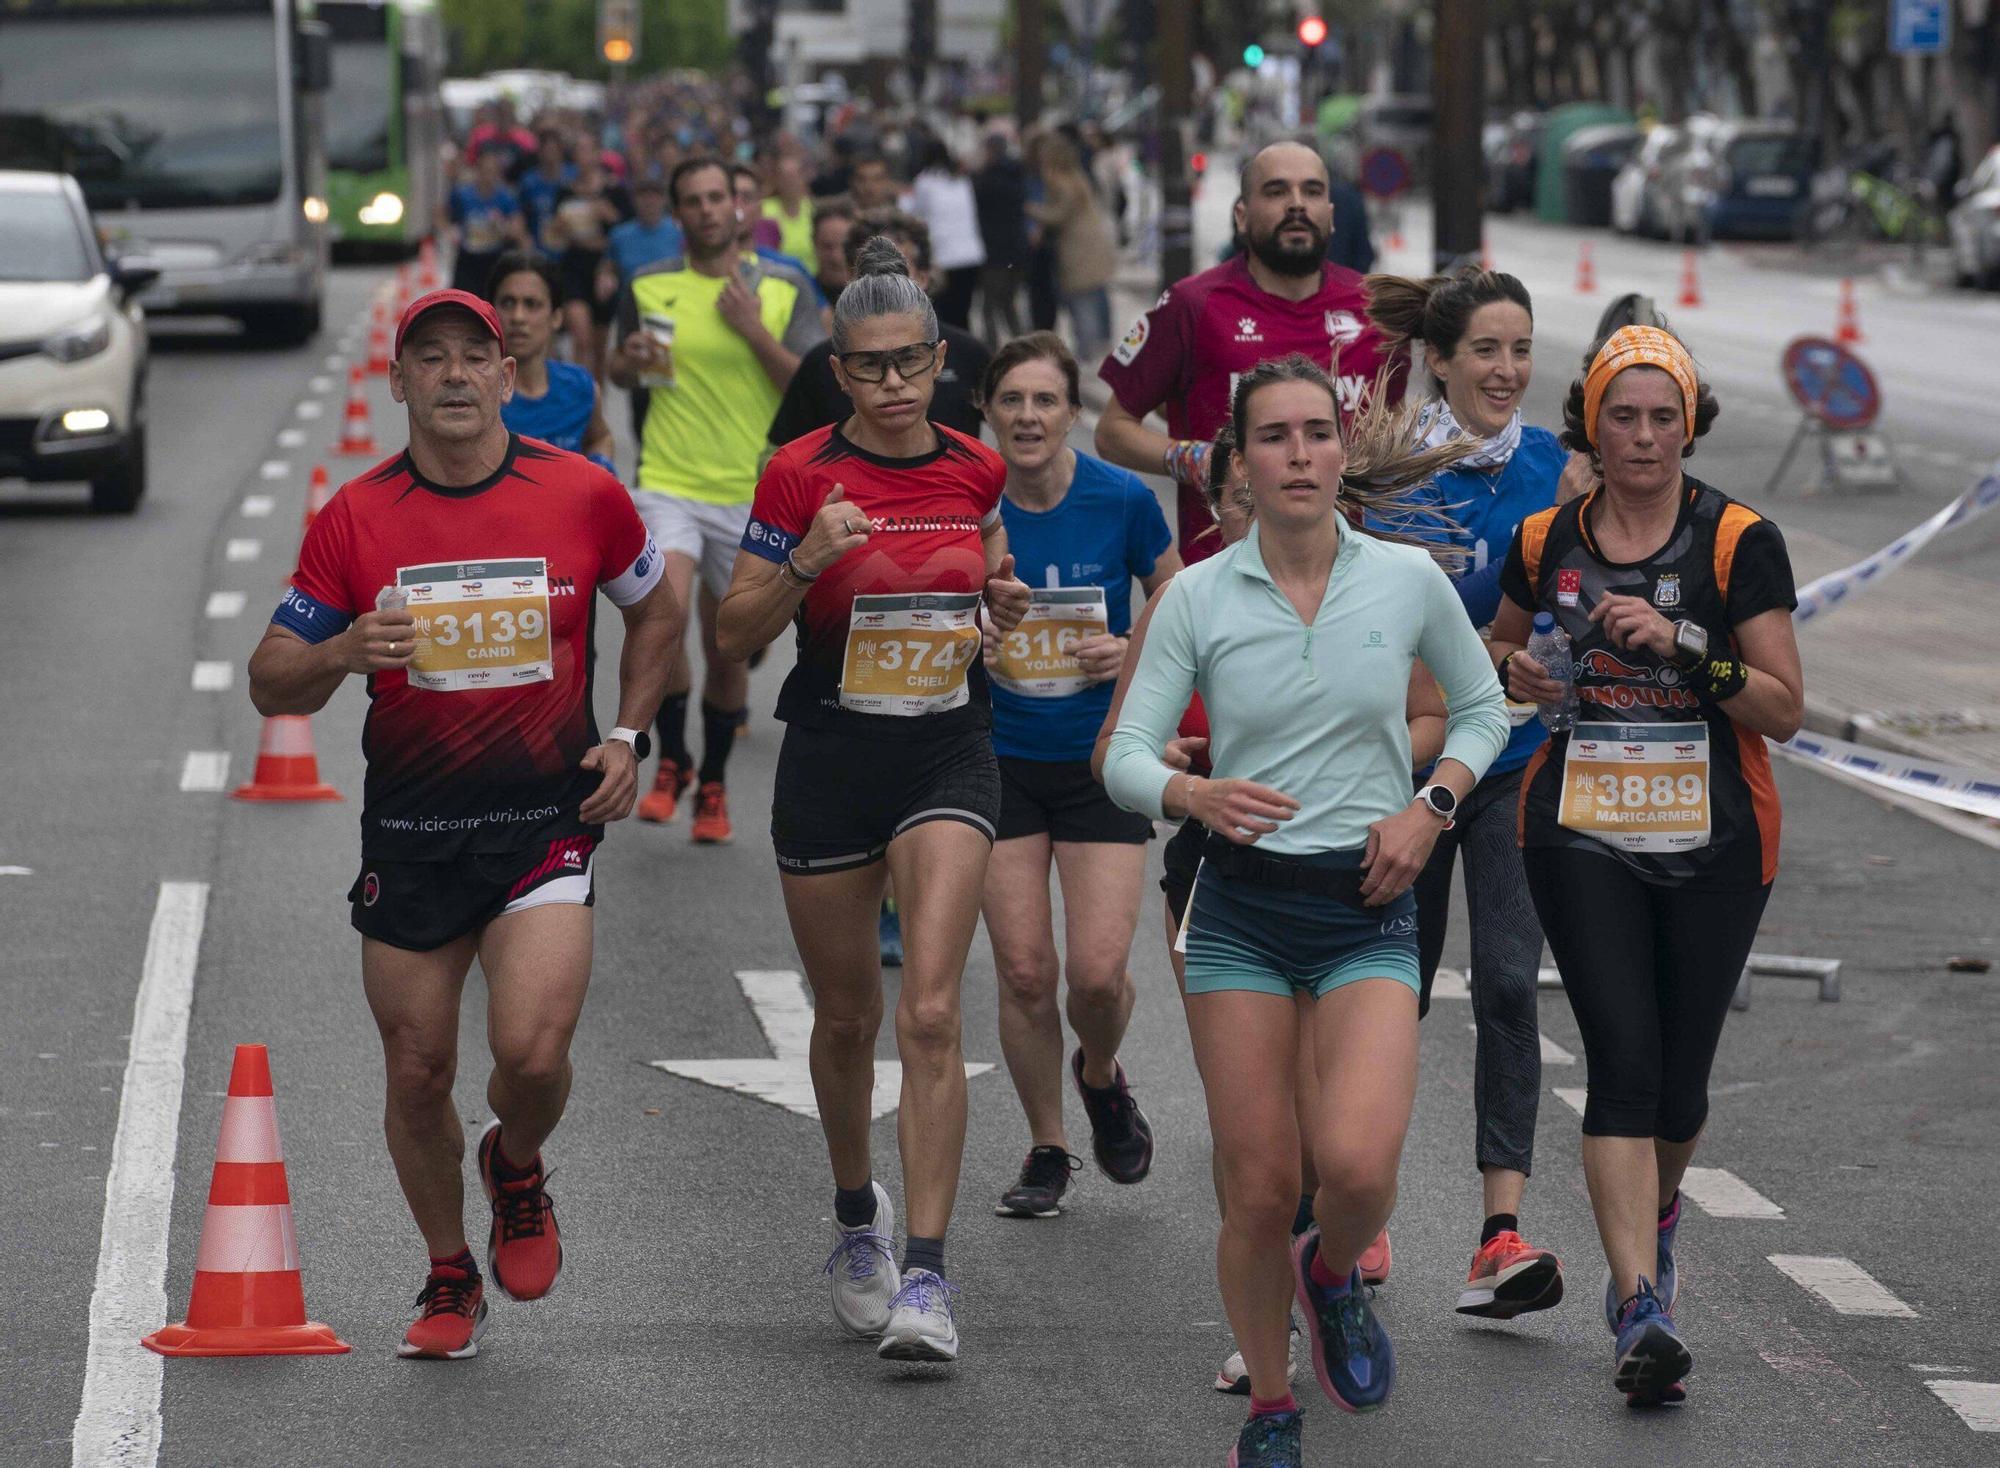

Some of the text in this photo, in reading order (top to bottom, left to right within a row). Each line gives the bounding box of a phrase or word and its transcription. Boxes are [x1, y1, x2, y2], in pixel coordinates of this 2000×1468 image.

[434, 608, 544, 646] 3139
[467, 647, 516, 659] CANDI
[1025, 657, 1088, 671] YOLAND
[1596, 773, 1703, 807] 3889
[1596, 810, 1702, 823] MARICARMEN
